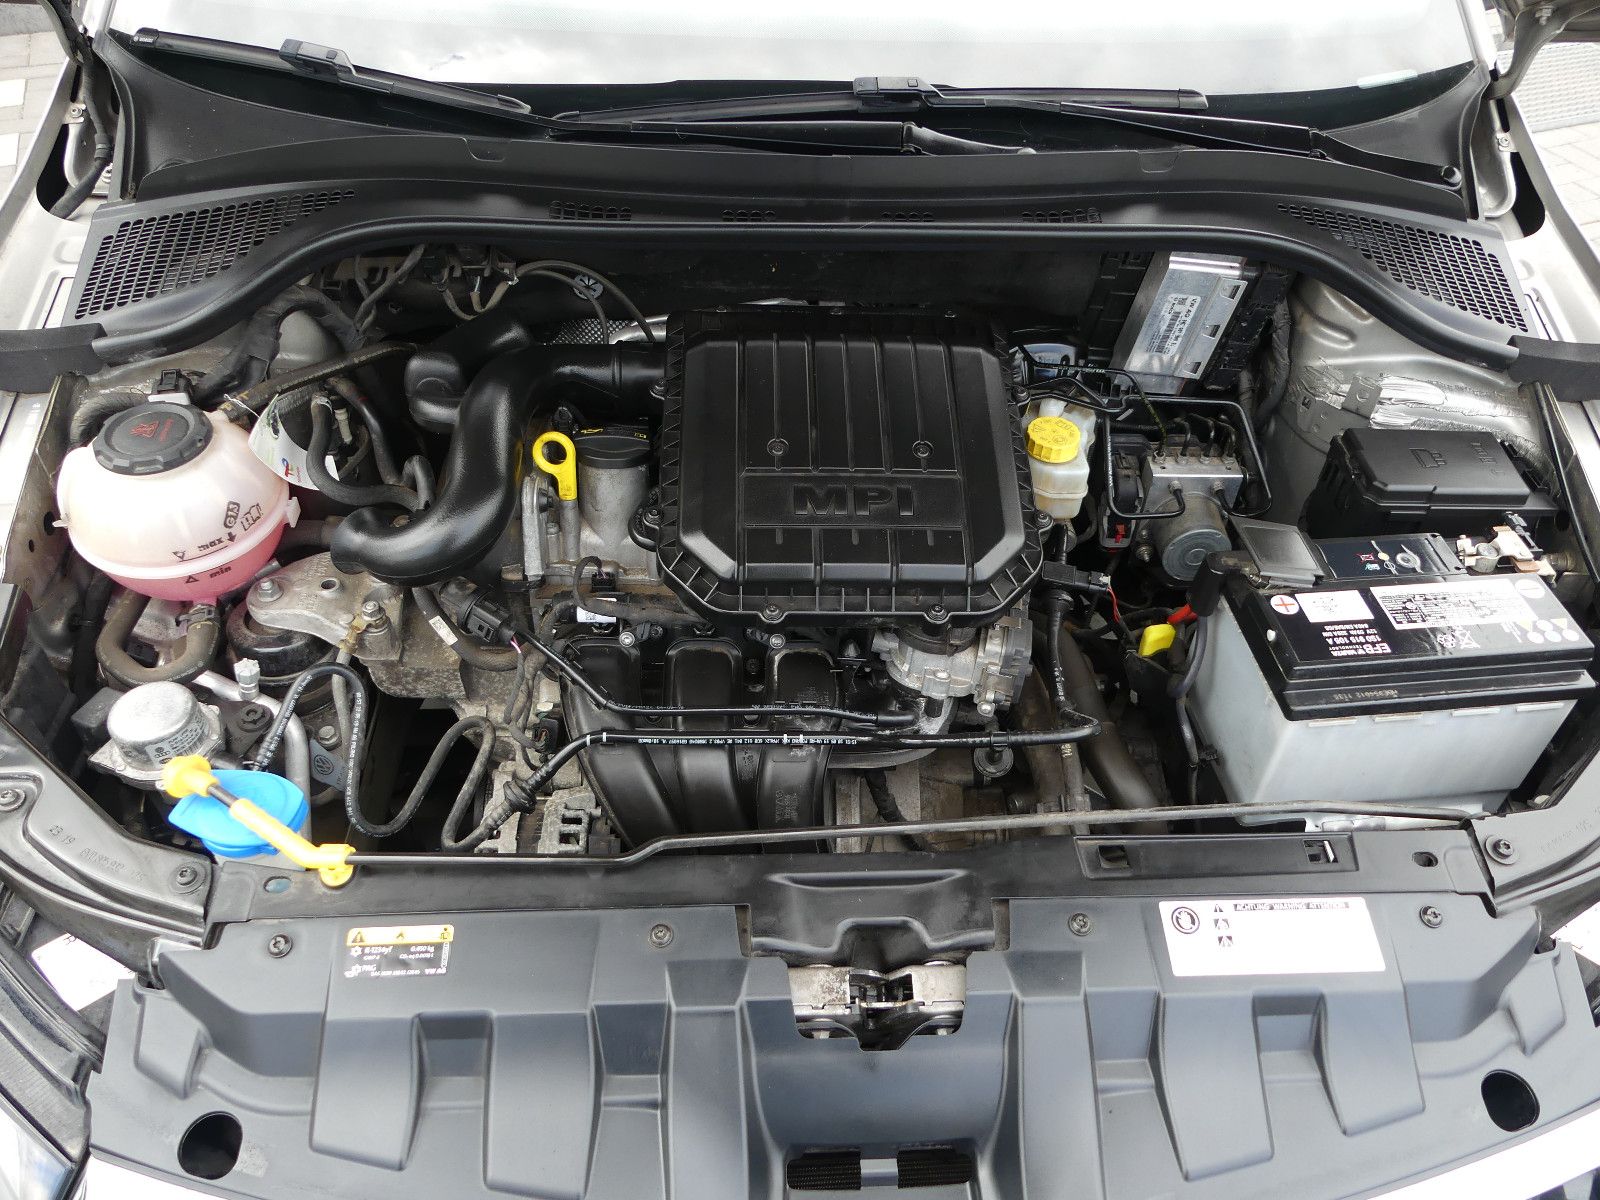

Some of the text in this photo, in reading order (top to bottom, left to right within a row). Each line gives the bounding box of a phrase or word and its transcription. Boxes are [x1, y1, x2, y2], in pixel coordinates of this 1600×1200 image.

[792, 484, 915, 516] MPI
[225, 503, 239, 527] G13
[198, 537, 225, 552] max
[209, 566, 232, 579] min
[1363, 643, 1392, 654] EFB
[1236, 903, 1269, 911] ACHTUNG
